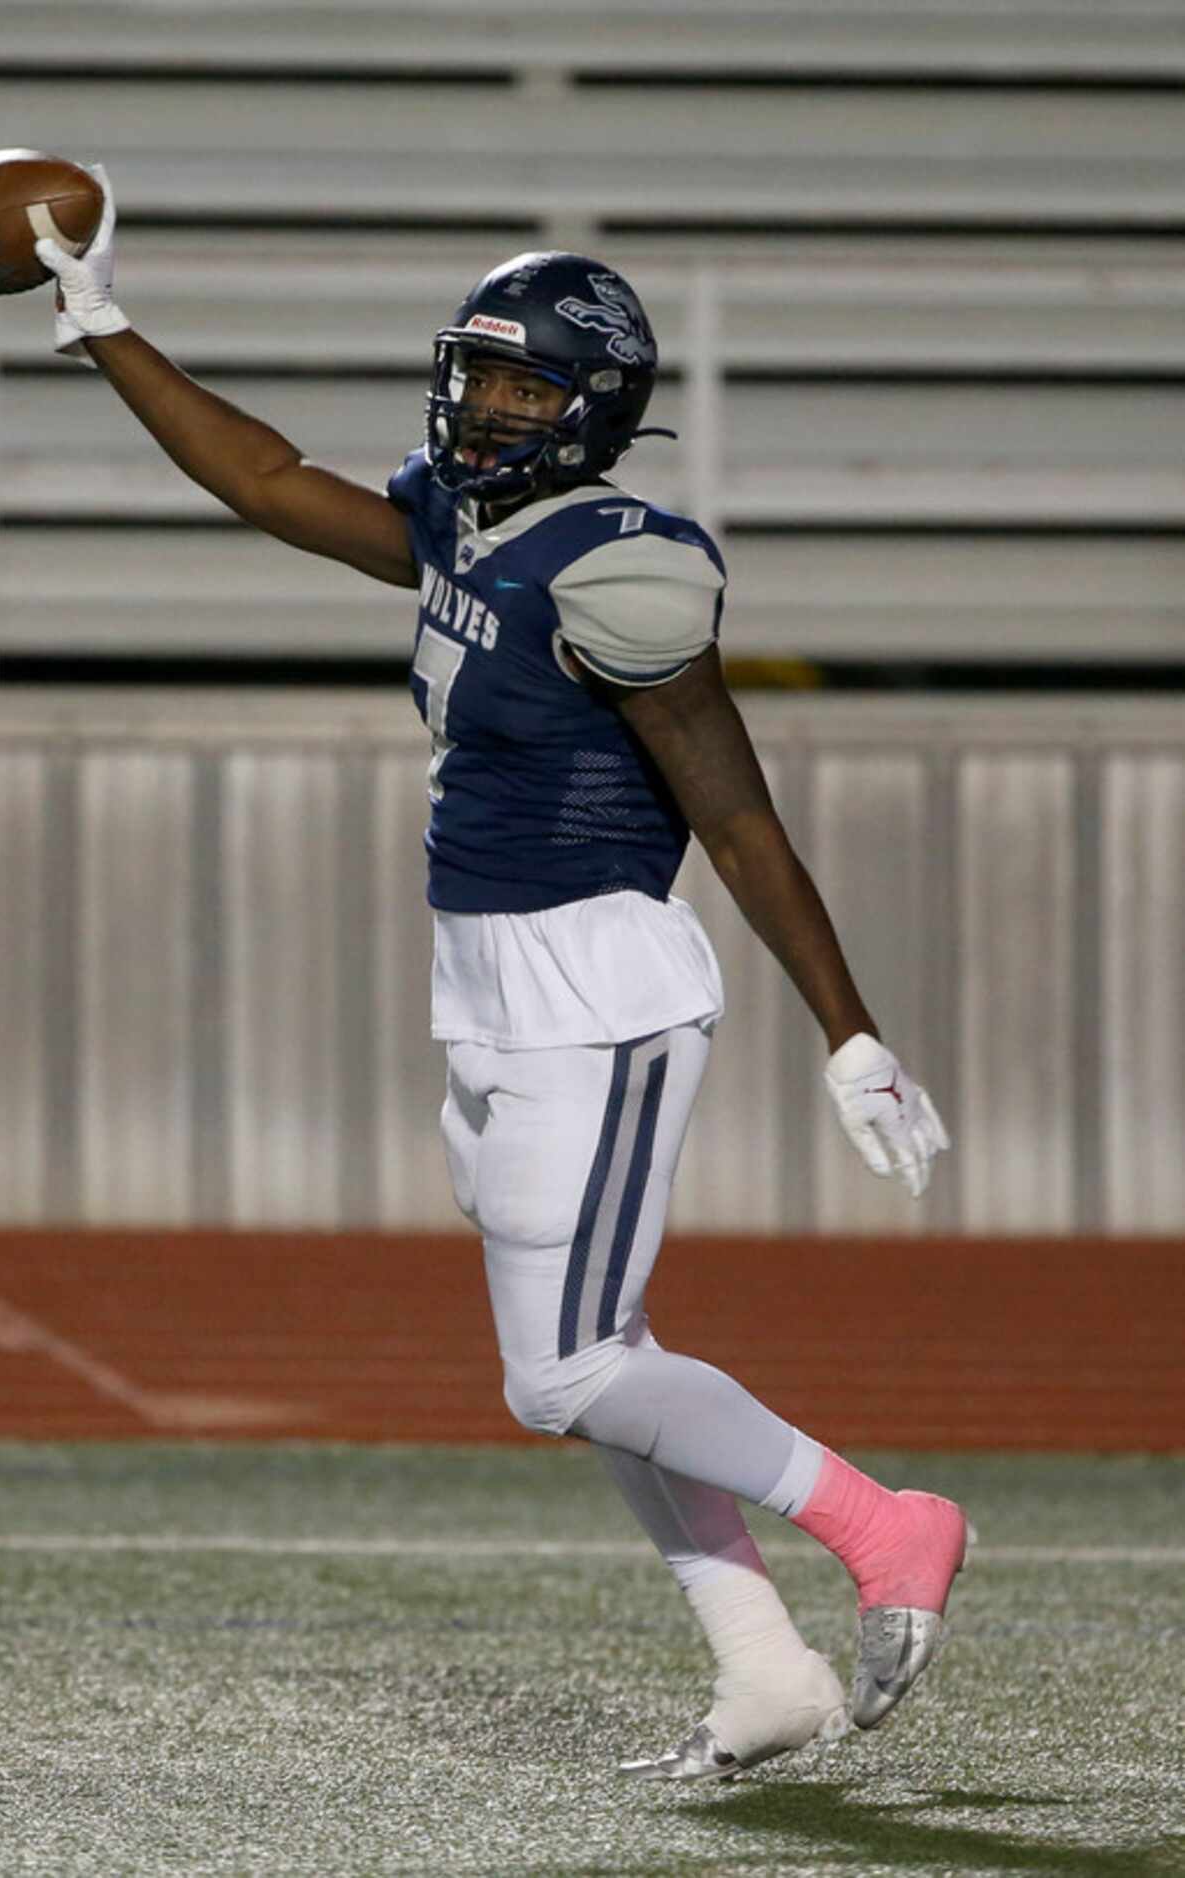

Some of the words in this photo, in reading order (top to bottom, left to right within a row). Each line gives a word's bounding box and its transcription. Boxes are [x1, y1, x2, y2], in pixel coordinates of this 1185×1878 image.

[471, 316, 519, 335] Riddell
[597, 506, 647, 534] 7
[420, 562, 501, 651] WOLVES
[413, 623, 467, 804] 7
